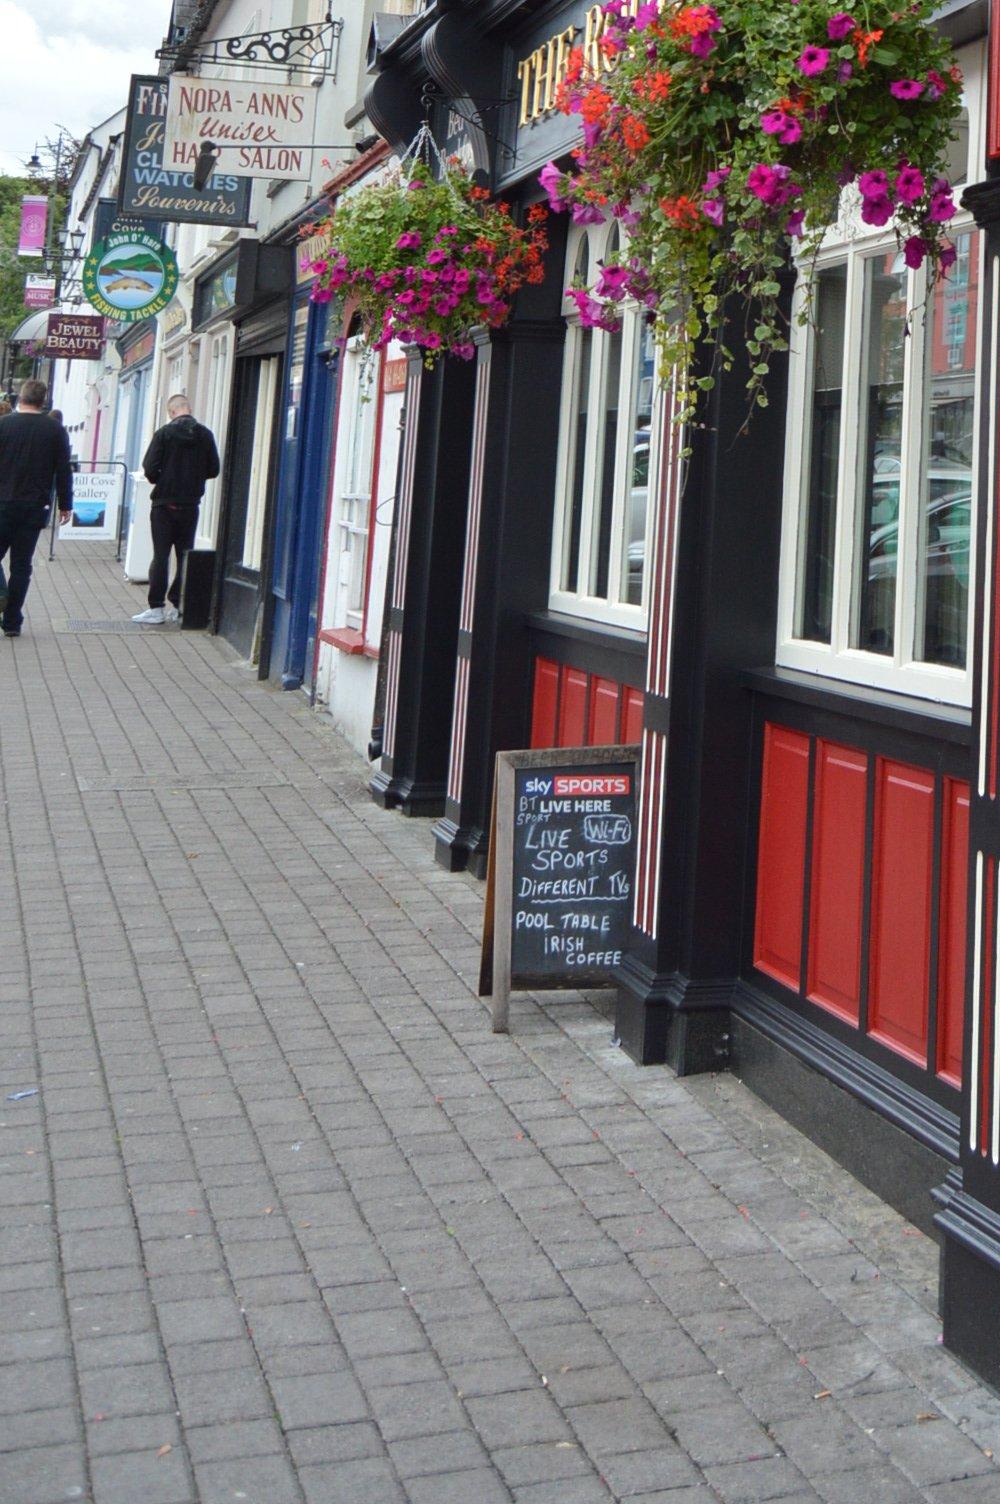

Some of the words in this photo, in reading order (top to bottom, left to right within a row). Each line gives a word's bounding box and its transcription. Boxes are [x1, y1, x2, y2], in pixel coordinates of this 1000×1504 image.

[518, 25, 576, 129] THE
[198, 116, 283, 143] Unisex
[238, 145, 303, 173] SALON
[131, 185, 236, 215] Souvenirs
[108, 234, 130, 248] John
[91, 292, 127, 321] FISHING
[130, 297, 167, 321] TACKLE
[52, 323, 101, 337] JEWEL
[46, 335, 102, 350] BEAUTY
[91, 477, 116, 486] Cove
[73, 488, 109, 500] Gallery
[526, 777, 552, 796] sky
[557, 777, 626, 794] SPORTS
[519, 797, 537, 813] BT
[540, 800, 572, 813] LIVE
[574, 799, 612, 813] HERE
[517, 813, 551, 826] SPORT
[524, 823, 573, 849] LIVE
[586, 820, 629, 841] Wi-Fi
[532, 849, 609, 871] SPORTS
[516, 911, 555, 930] POOL
[560, 913, 611, 931] TABLE
[566, 950, 622, 966] COFFEE
